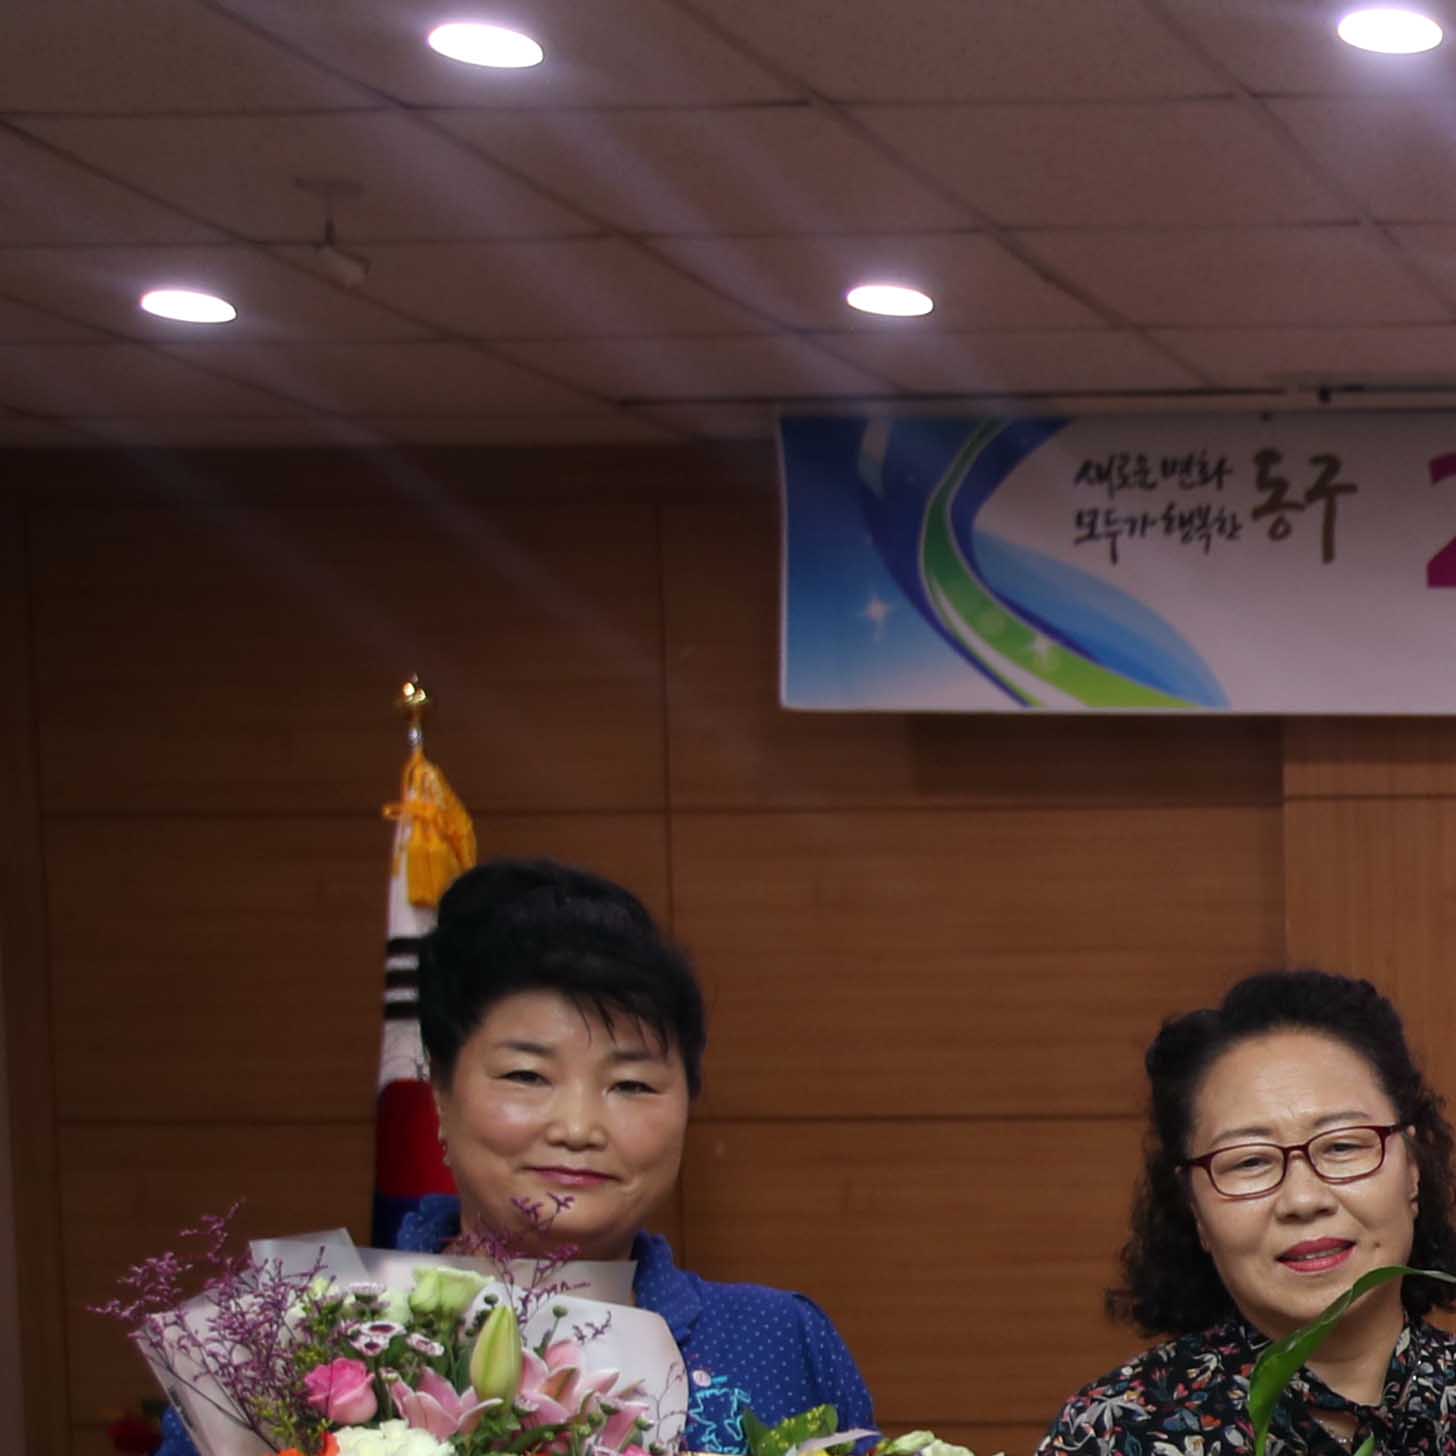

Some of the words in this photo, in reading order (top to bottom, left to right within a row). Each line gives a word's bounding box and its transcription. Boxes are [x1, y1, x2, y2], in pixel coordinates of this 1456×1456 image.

[1074, 453, 1157, 497] 새로운
[1160, 449, 1233, 490] 변화
[1074, 507, 1157, 564] 모두가
[1161, 502, 1243, 554] 행복한
[1250, 448, 1358, 564] 동구
